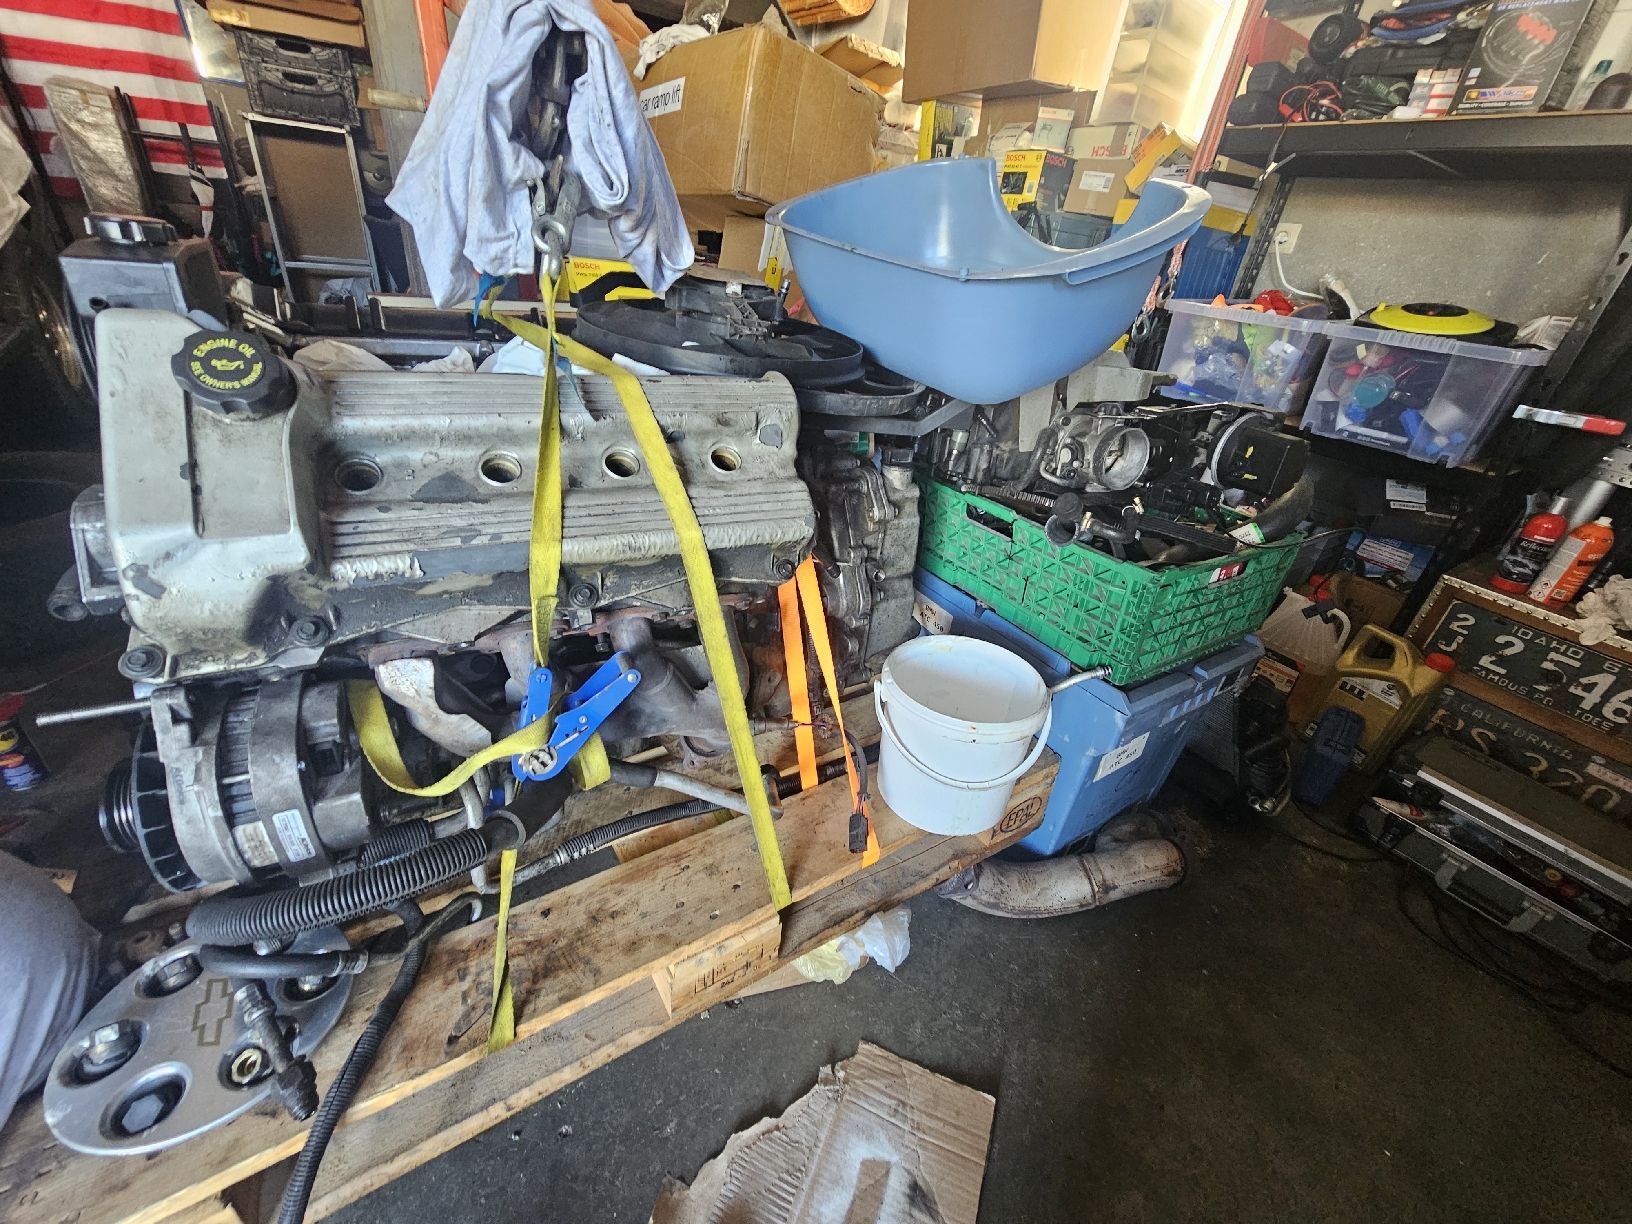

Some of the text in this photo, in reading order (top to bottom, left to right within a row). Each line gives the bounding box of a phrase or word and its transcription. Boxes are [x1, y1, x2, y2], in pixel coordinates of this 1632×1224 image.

[652, 91, 671, 111] ramp
[671, 83, 681, 104] lift
[1006, 154, 1026, 162] BOSCH
[574, 261, 600, 270] BOSCH
[193, 338, 256, 359] ENGINE OIL
[190, 361, 263, 390] SEE OWNER'S MANUAL
[1511, 625, 1585, 660] IDAHO
[1460, 702, 1574, 761] CALIFORNIA
